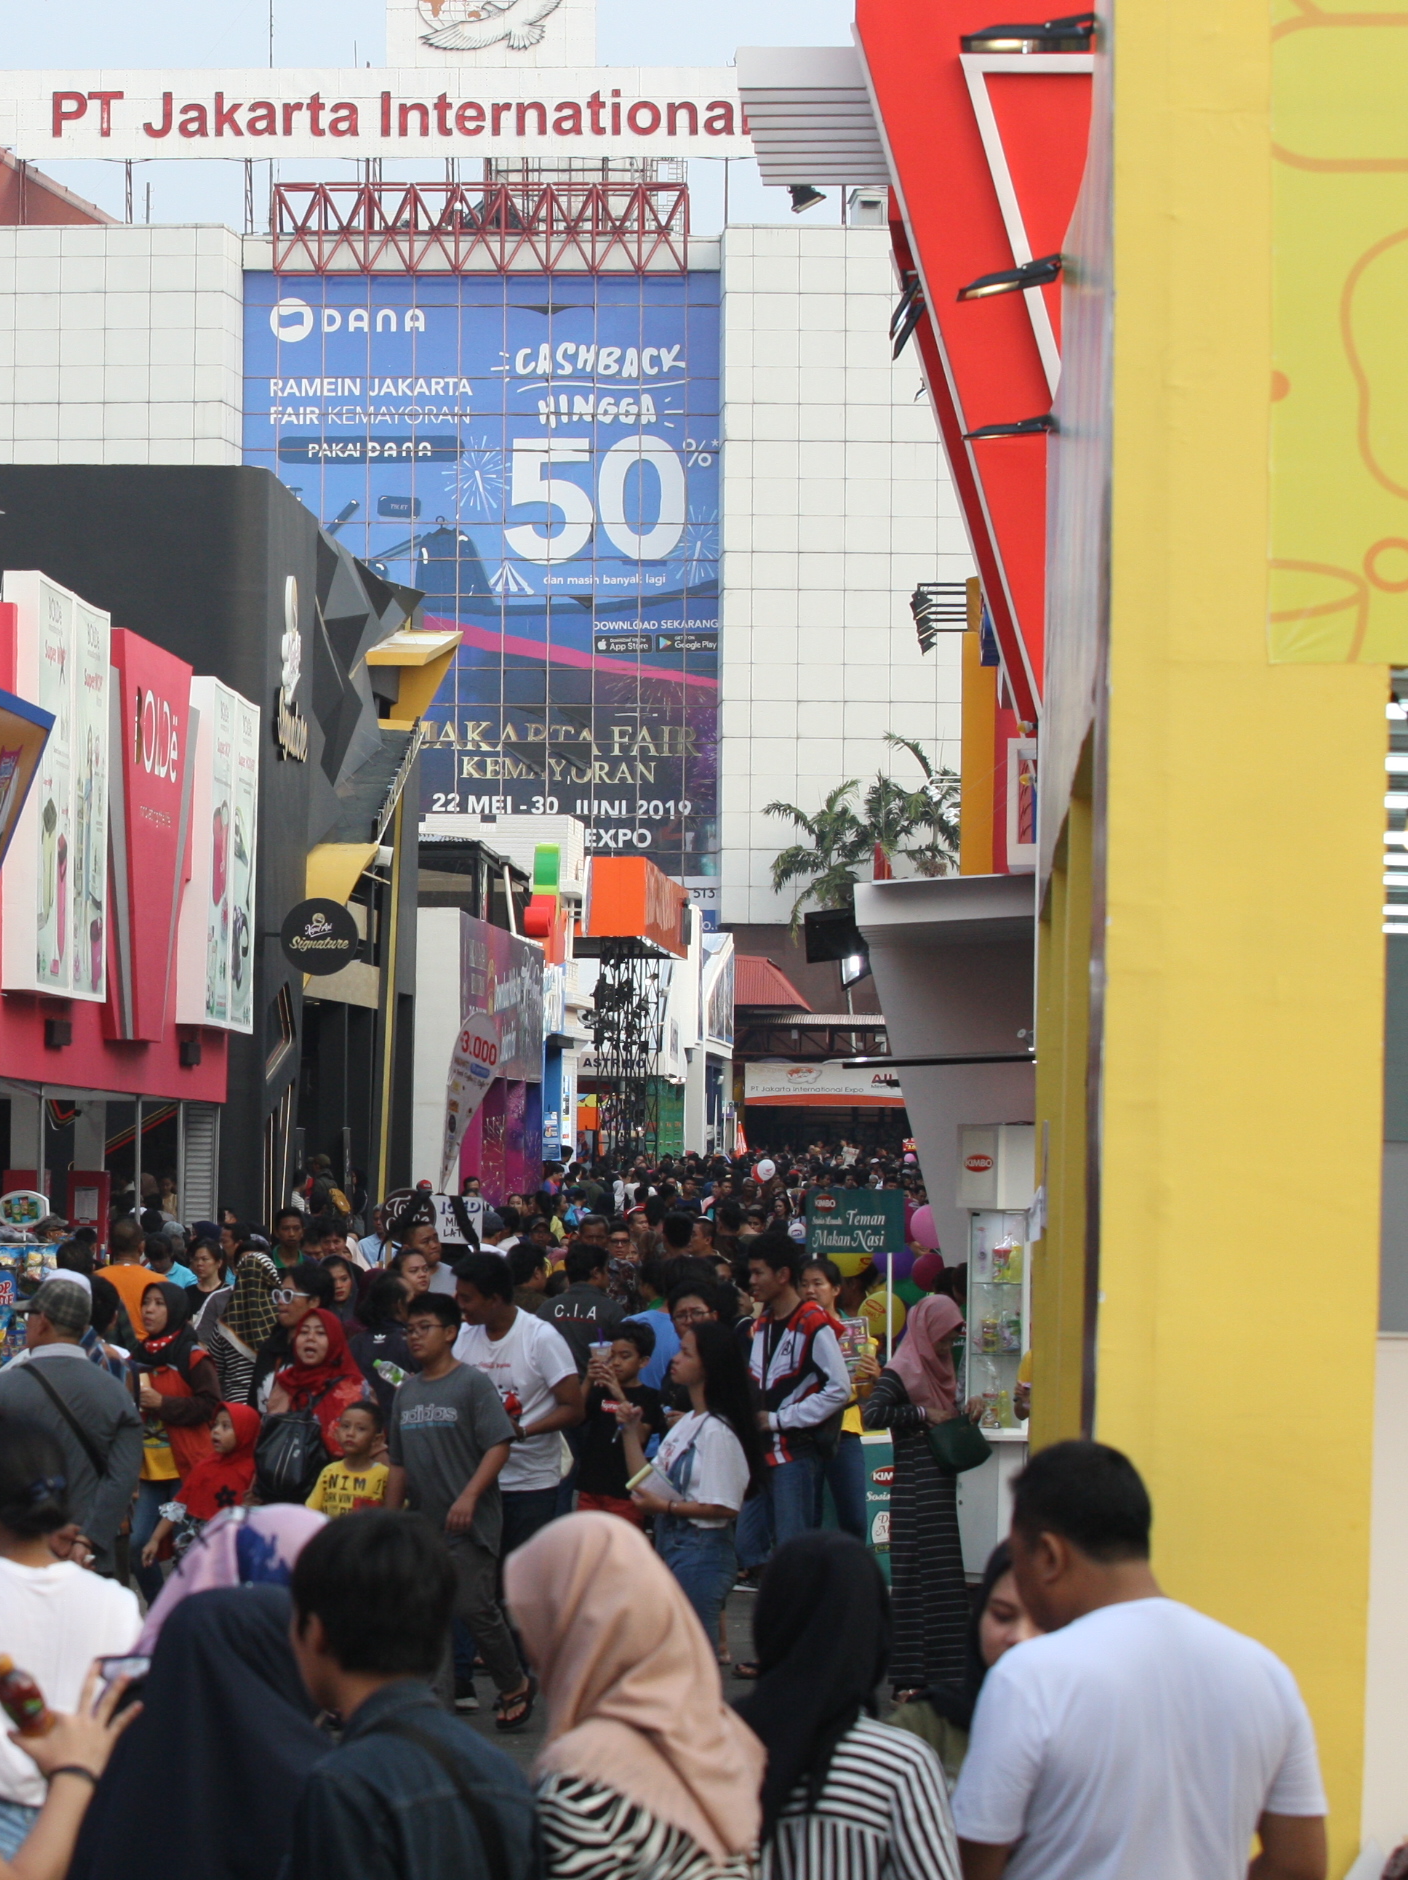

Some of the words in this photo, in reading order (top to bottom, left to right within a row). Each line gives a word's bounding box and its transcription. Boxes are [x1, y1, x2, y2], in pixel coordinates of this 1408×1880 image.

[51, 90, 124, 138] PT
[142, 90, 360, 139] Jakarta
[380, 89, 754, 138] Internationa
[321, 308, 426, 332] DANA
[515, 342, 686, 377] CASHBACK
[270, 378, 360, 397] RAMEIN
[369, 378, 473, 396] JAKARTA
[270, 406, 320, 425] FAIR
[328, 405, 471, 425] KEMAYORAN
[538, 394, 657, 428] HINGGA
[308, 443, 360, 457] PAKAI
[367, 441, 432, 457] DANA
[543, 573, 564, 585] dan
[645, 572, 666, 586] lagi
[593, 620, 659, 631] DOWNLOAD
[660, 619, 719, 629] SEKARANG
[609, 643, 626, 652] App
[627, 642, 649, 651] Store
[674, 640, 701, 650] Google
[702, 640, 718, 650] Play
[610, 725, 703, 758] FAIR
[432, 793, 460, 813] 22
[467, 795, 512, 814] MEI
[530, 796, 559, 815] 30
[635, 800, 692, 820] 2019
[584, 828, 652, 848] EXPO
[289, 935, 350, 952] Signature
[761, 1085, 791, 1093] Jakarta
[792, 1085, 843, 1093] International
[844, 1086, 865, 1094] Expo
[965, 1158, 993, 1168] KIMBO
[814, 1198, 836, 1208] KIMBO
[846, 1208, 885, 1227] Teman
[811, 1229, 851, 1248] Makan
[850, 1230, 885, 1252] Nasi
[400, 1402, 458, 1425] adidas
